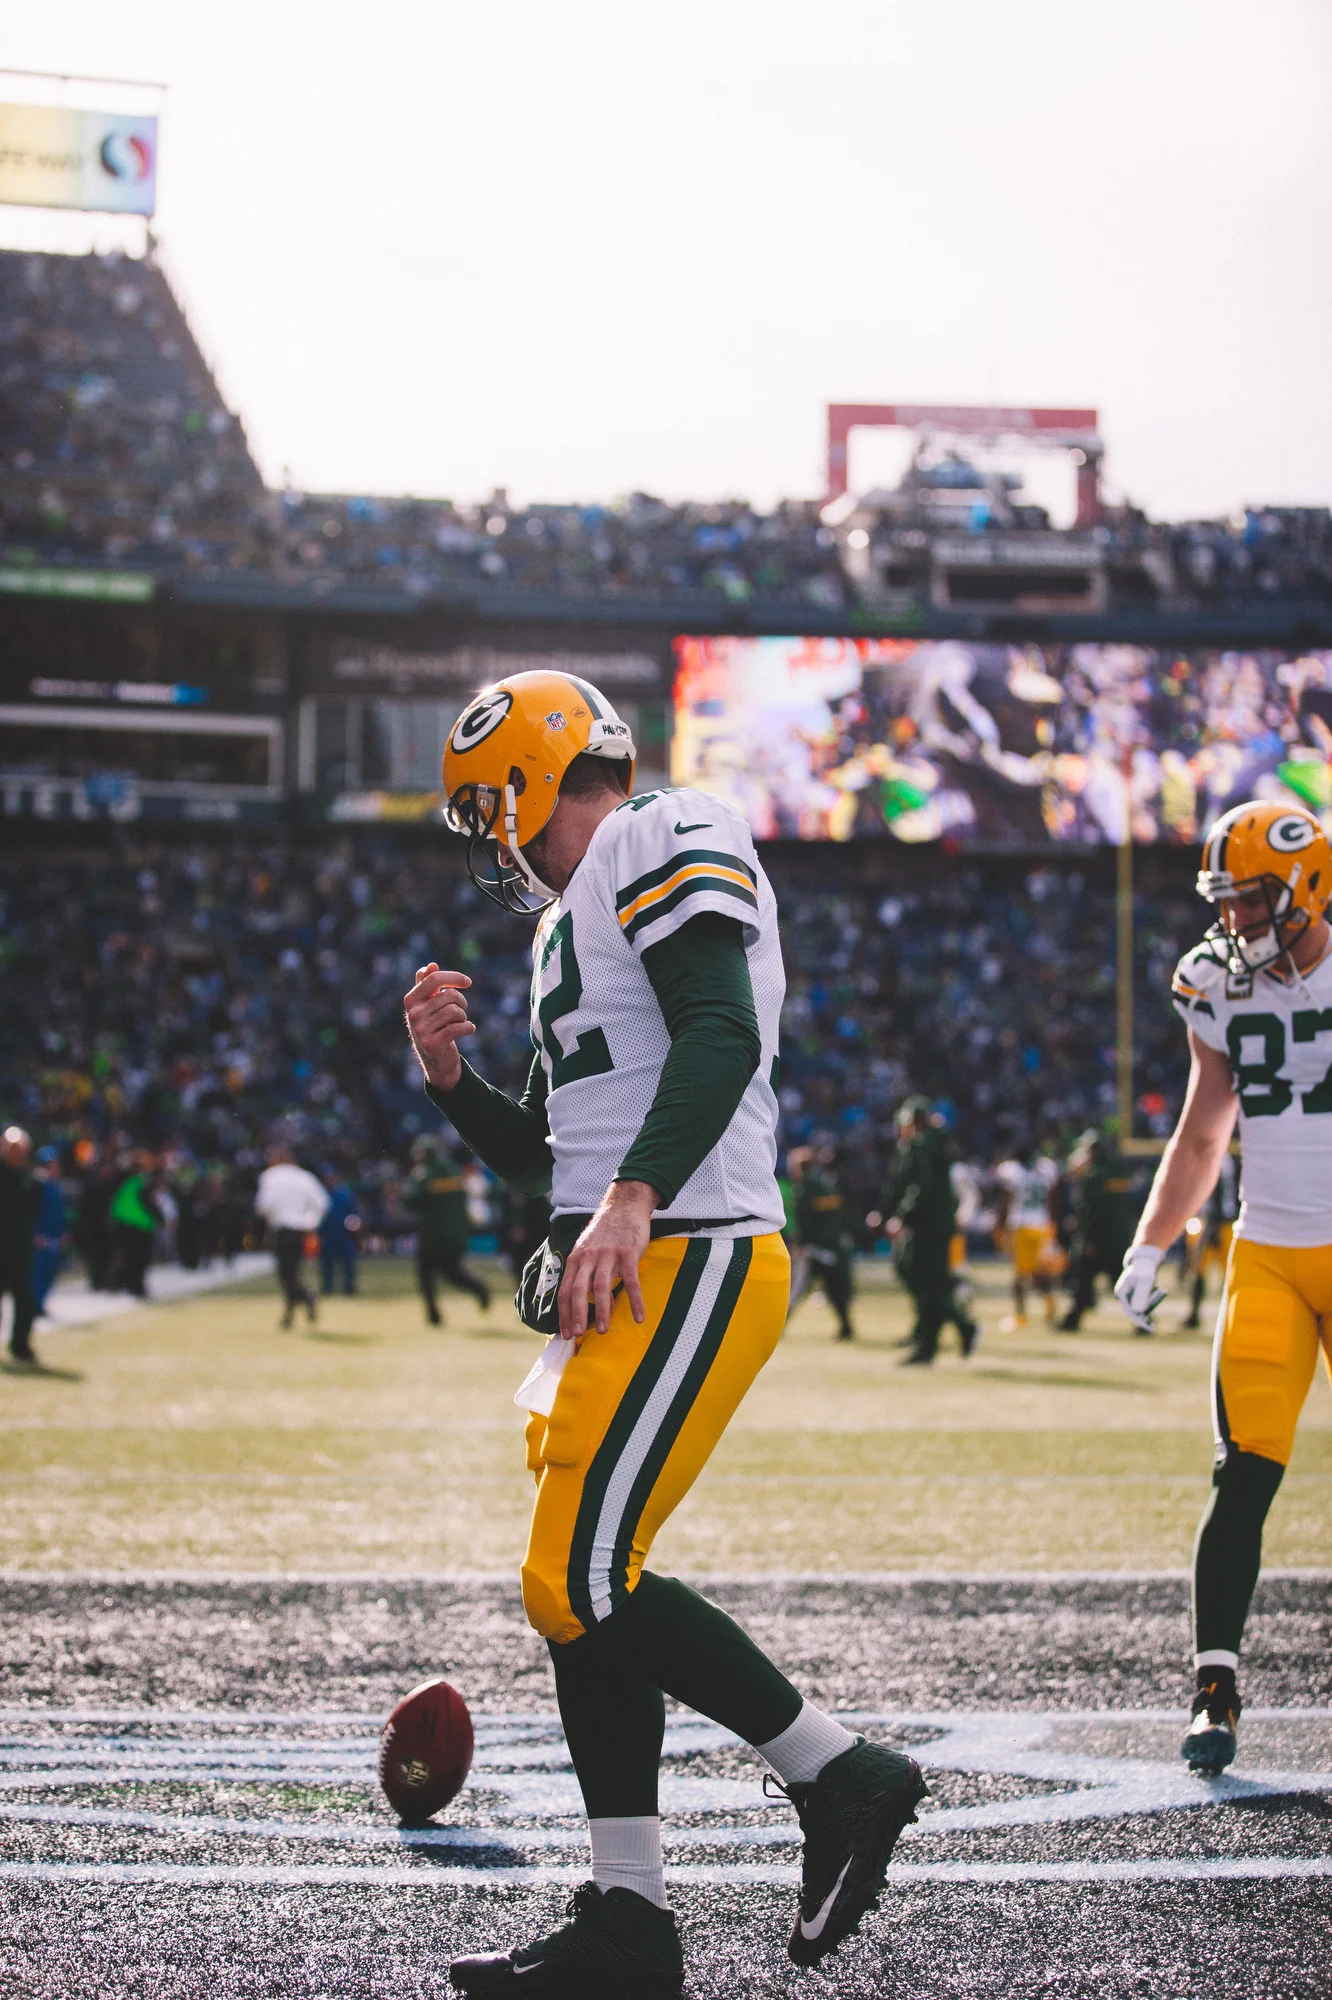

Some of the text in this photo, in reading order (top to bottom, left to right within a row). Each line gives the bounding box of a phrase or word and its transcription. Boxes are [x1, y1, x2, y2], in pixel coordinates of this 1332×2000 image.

[452, 692, 512, 753] G
[551, 718, 565, 729] NFL
[1267, 814, 1315, 852] G
[1226, 1012, 1332, 1117] 87
